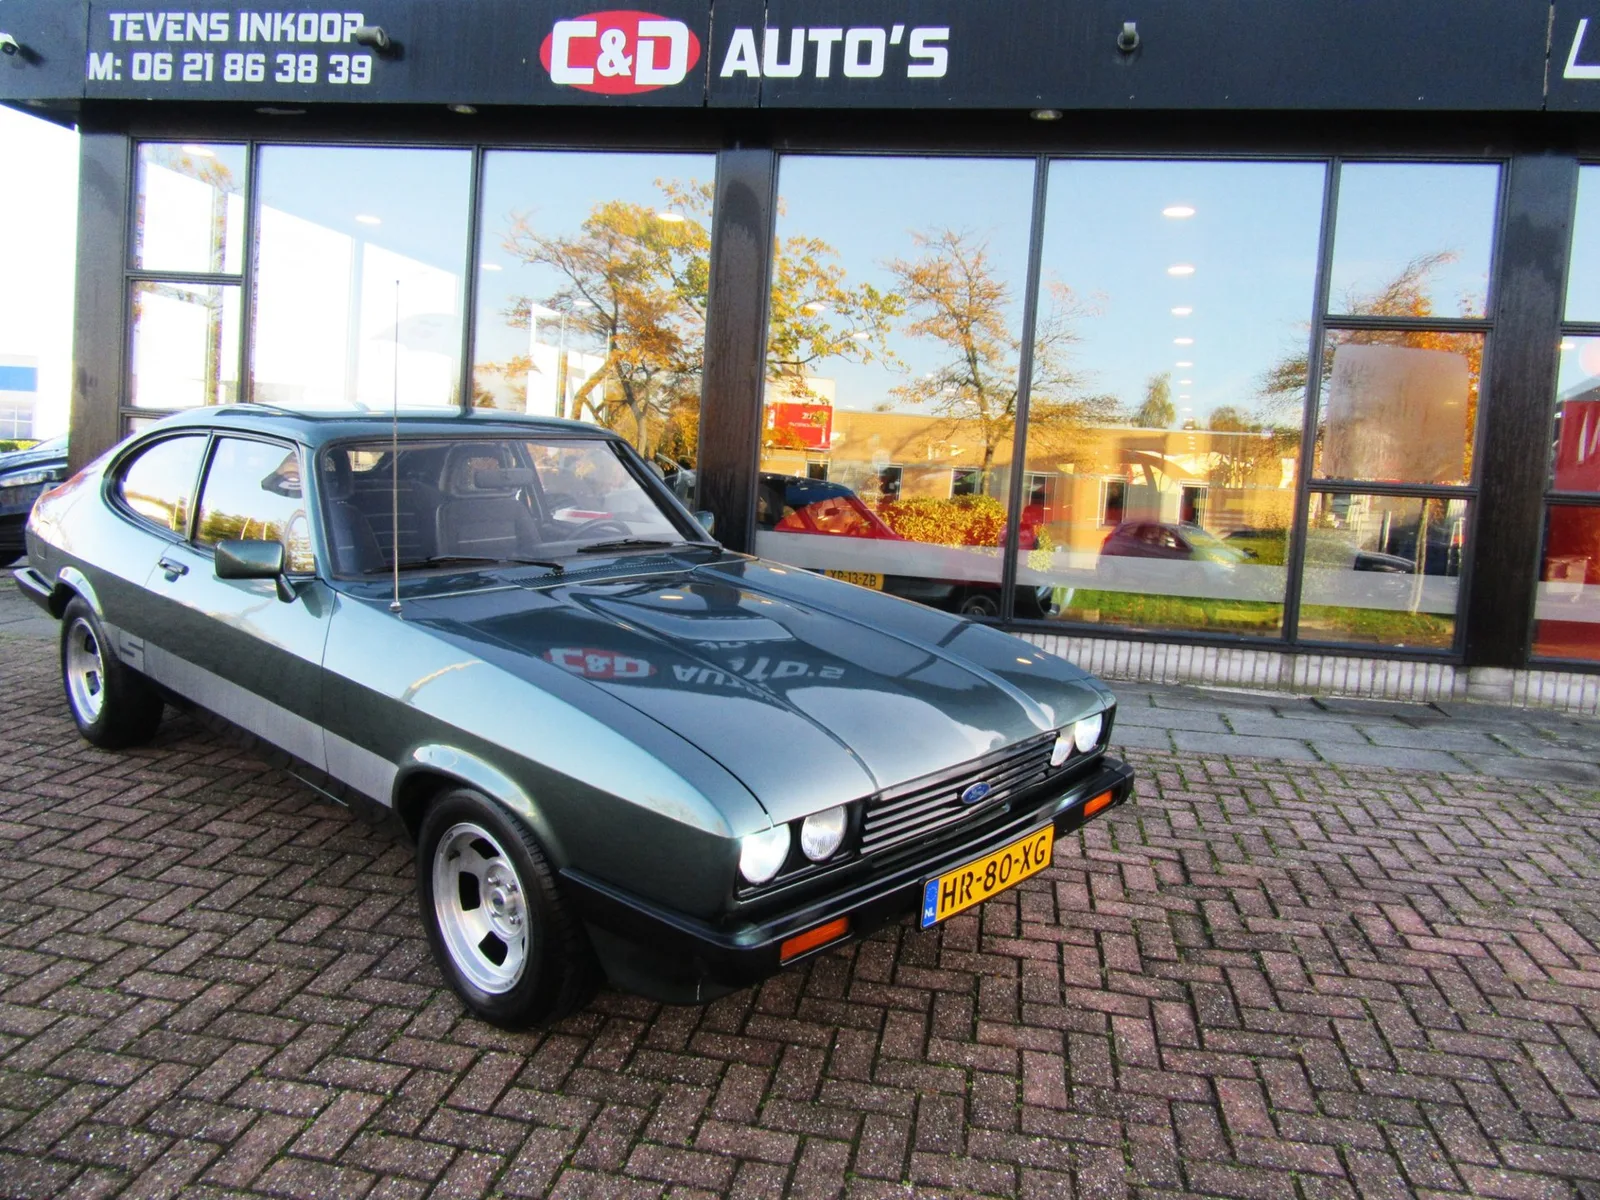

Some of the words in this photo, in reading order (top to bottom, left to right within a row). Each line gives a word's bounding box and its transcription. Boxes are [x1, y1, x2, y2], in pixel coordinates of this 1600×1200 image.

[110, 13, 229, 41] TEVENS
[239, 13, 365, 42] INKOOP
[550, 20, 690, 85] C&D
[720, 25, 949, 78] AUTO'S
[88, 53, 122, 81] M:
[132, 53, 172, 81] 06
[182, 54, 214, 81] 21
[224, 54, 265, 82] 86
[275, 55, 318, 83] 38
[328, 55, 372, 84] 39
[940, 835, 1047, 913] HR-80-XG
[924, 907, 935, 919] NL
